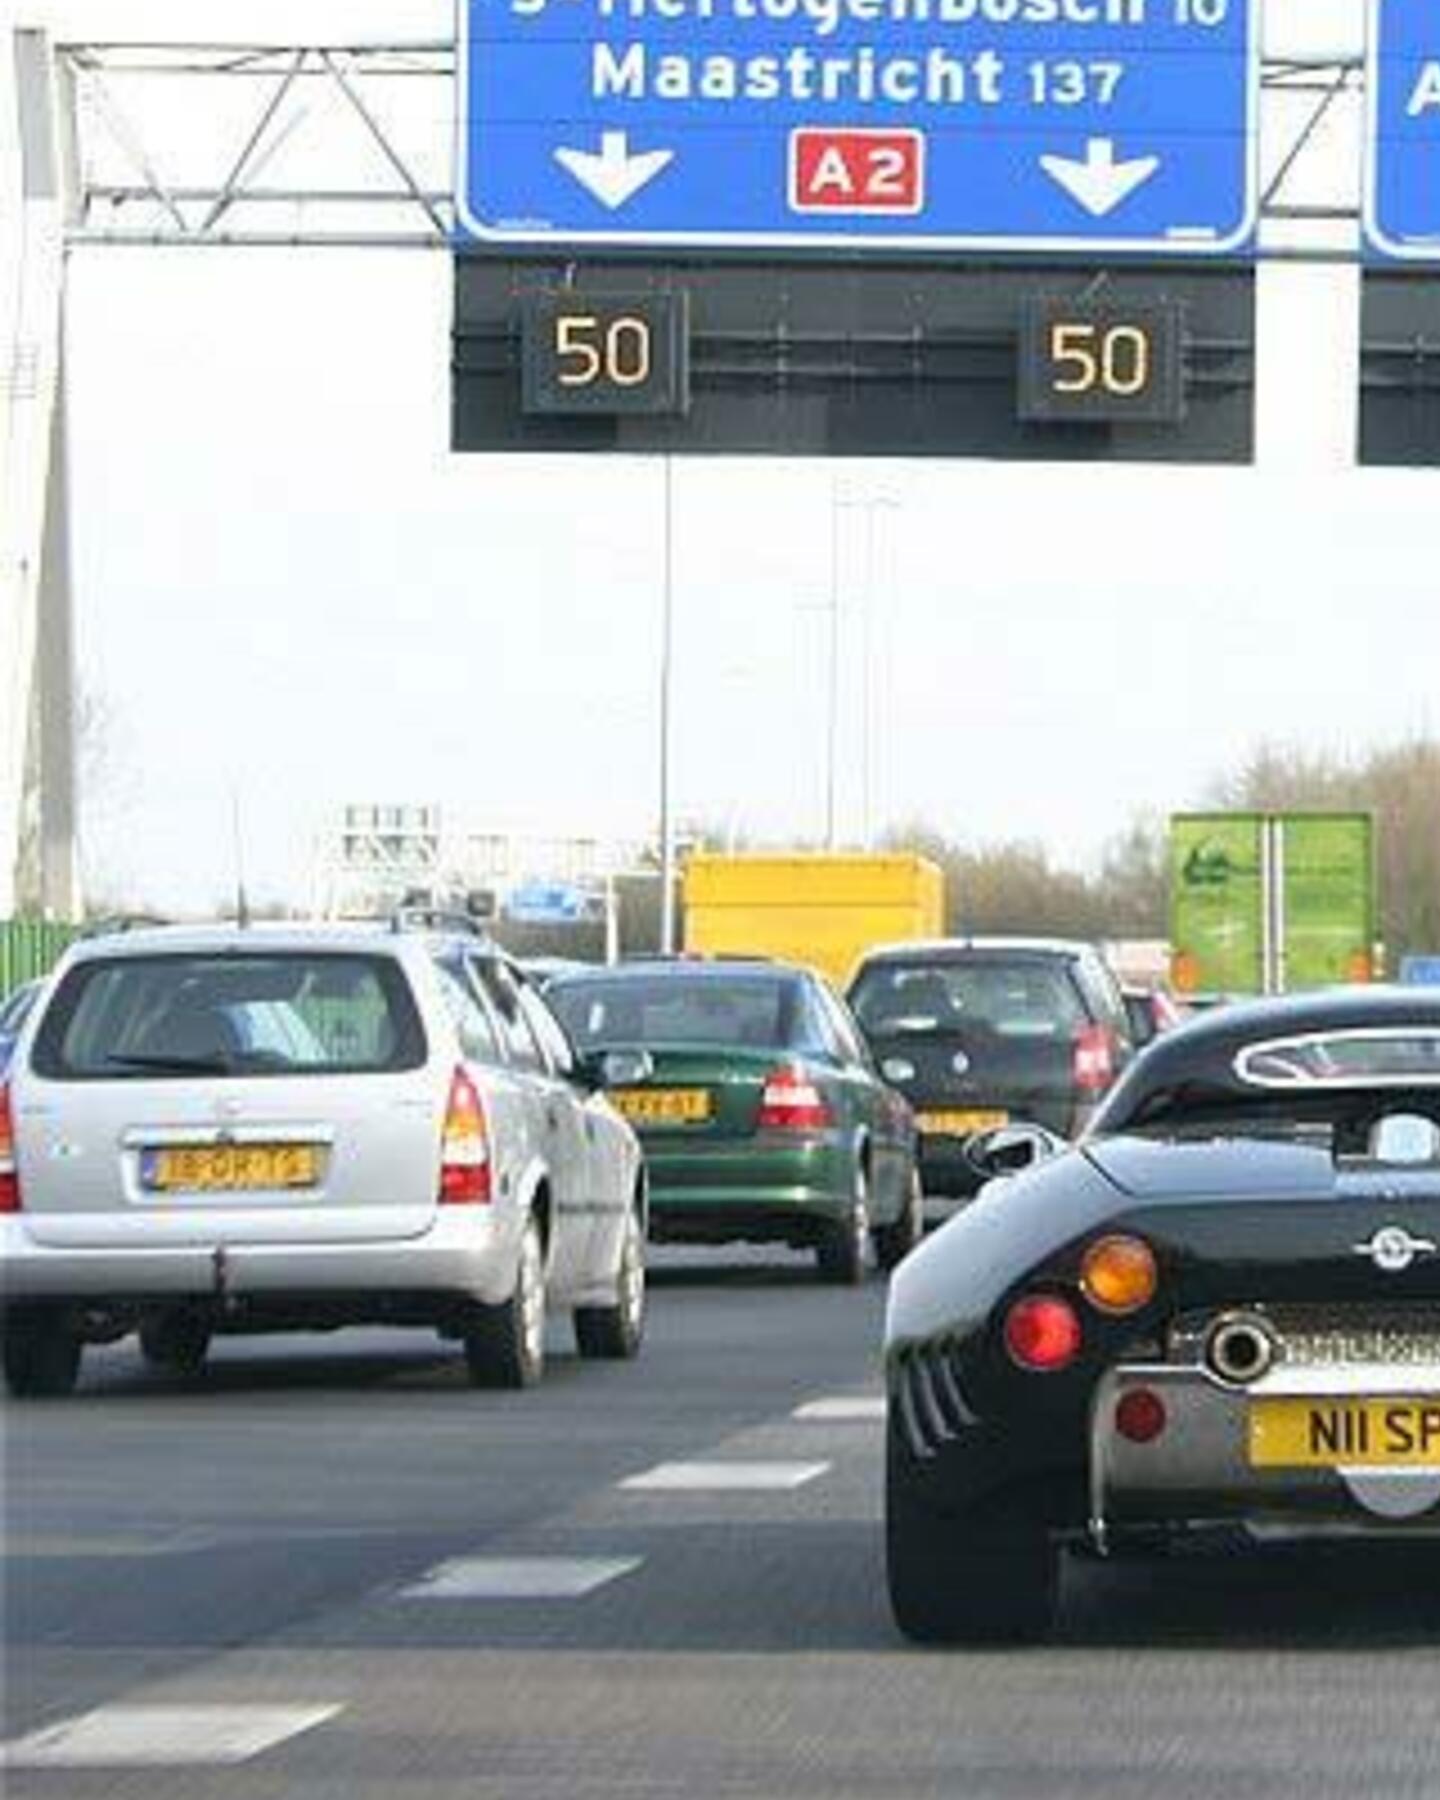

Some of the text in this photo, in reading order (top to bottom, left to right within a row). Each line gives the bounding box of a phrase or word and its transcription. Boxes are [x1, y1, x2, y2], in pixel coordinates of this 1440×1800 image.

[592, 42, 1122, 104] Maastricht 137
[808, 145, 906, 194] A2
[556, 316, 650, 385] 50
[1052, 325, 1147, 395] 50
